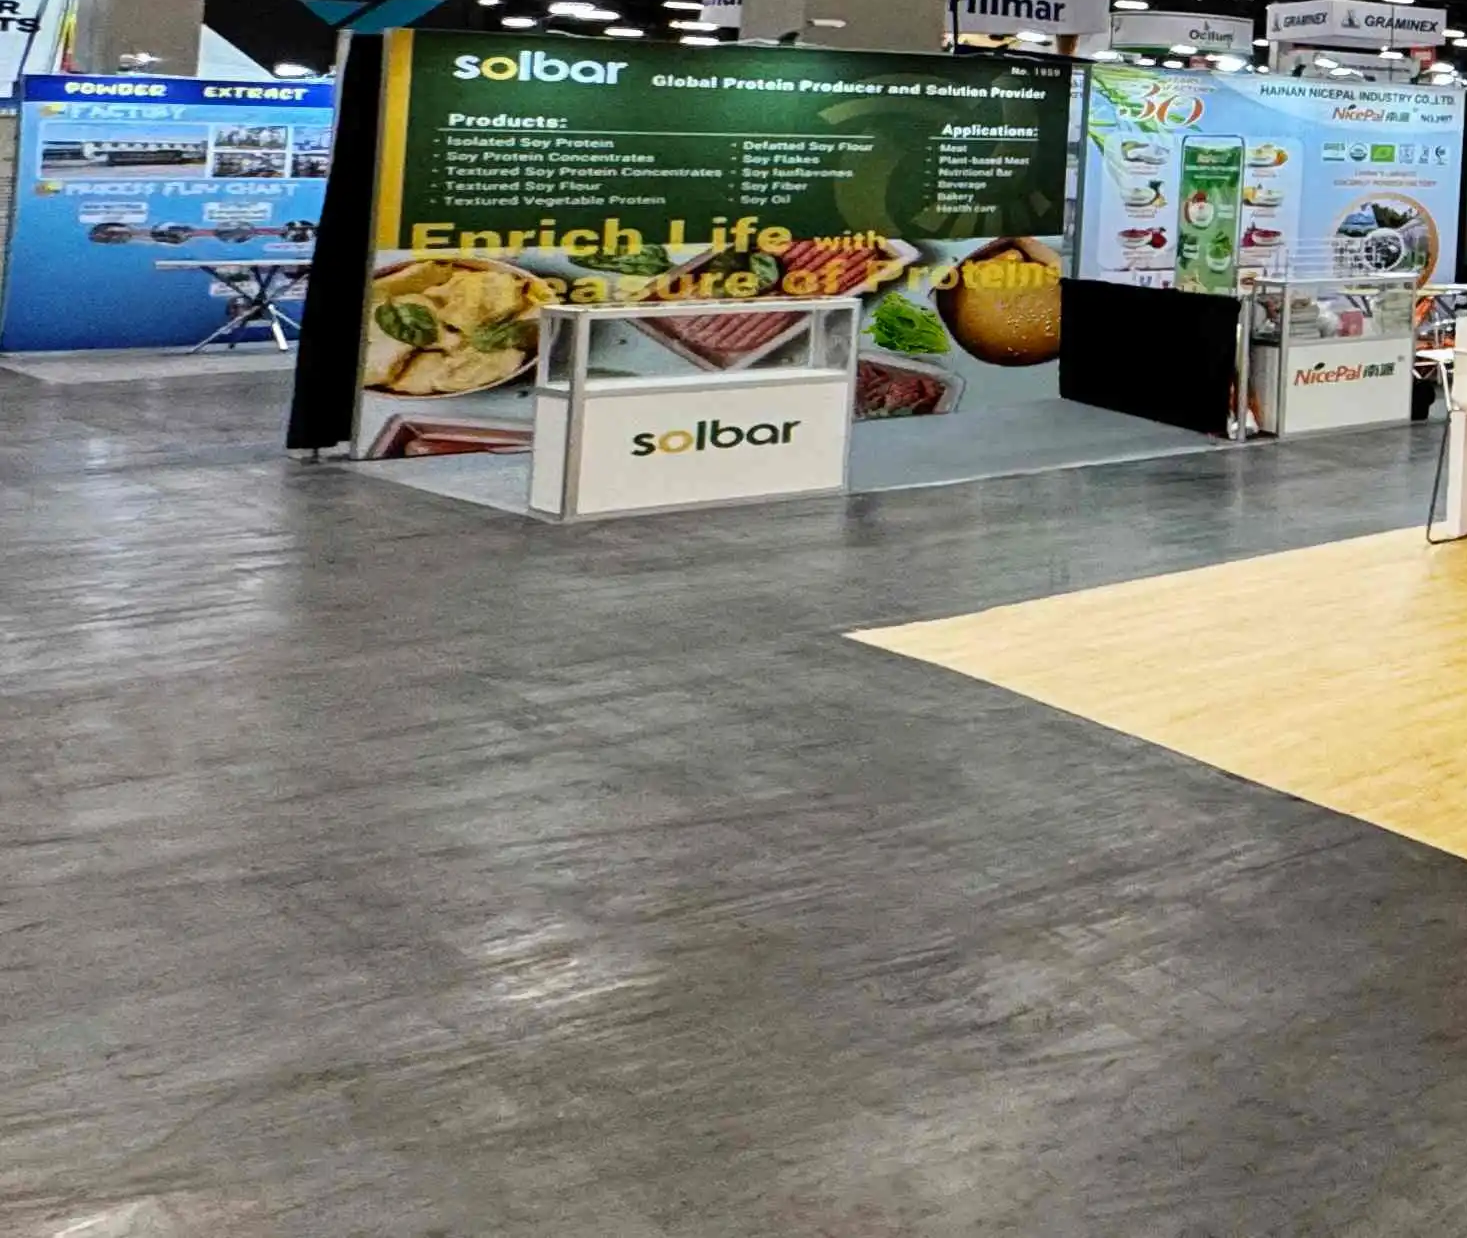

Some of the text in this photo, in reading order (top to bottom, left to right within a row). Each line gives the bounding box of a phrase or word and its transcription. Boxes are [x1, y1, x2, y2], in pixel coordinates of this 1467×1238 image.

[1283, 12, 1330, 29] GRAMINEX
[1364, 14, 1440, 33] GRAMINEX
[453, 50, 629, 85] solbar
[64, 82, 310, 101] POWDER EXTRACT
[651, 74, 1047, 100] Global Protein Producer and Solution Provider
[1260, 84, 1306, 96] HAINAN
[1308, 88, 1356, 101] NICEPAL
[1359, 92, 1413, 104] INDUSTRY
[448, 113, 568, 129] Products:
[941, 124, 1040, 139] Applications:
[447, 136, 615, 150] Isolated Soy Protein
[808, 141, 835, 153] Soy
[446, 151, 656, 163] Soy Protein Concentrates
[742, 154, 821, 165] Soy Flakes
[445, 166, 723, 178] Textured Soy Protein Concentrates
[741, 168, 770, 179] Soy
[444, 180, 603, 193] Textured Soy Flour
[741, 181, 808, 192] Soy Fiber
[443, 196, 667, 208] Textured Vegetable Protein
[740, 194, 792, 206] Soy Oil
[410, 217, 645, 262] Enrich
[813, 230, 887, 254] with
[541, 268, 760, 304] easure
[781, 259, 843, 297] of
[1293, 362, 1363, 387] NicePal
[631, 417, 802, 457] solbar
